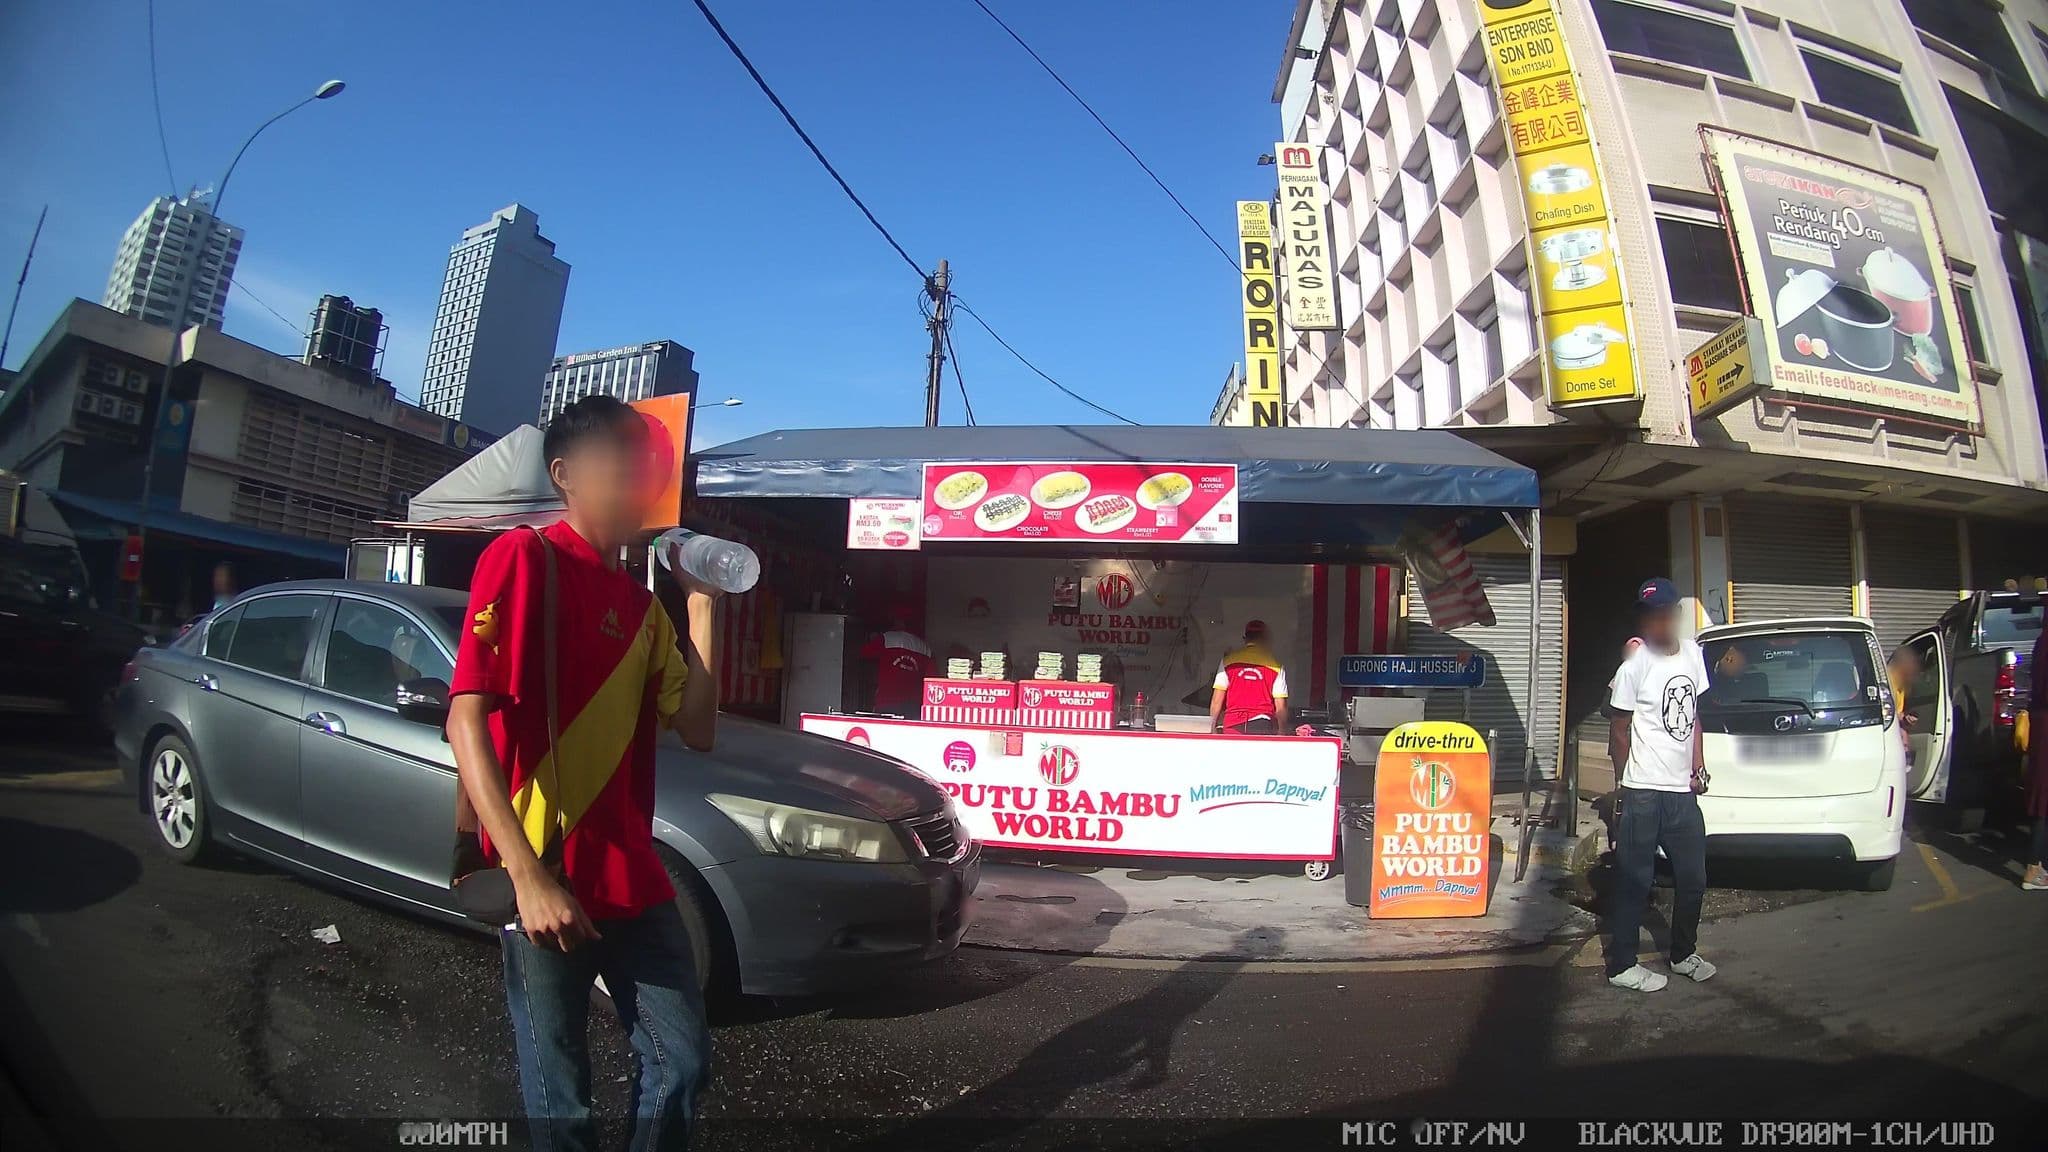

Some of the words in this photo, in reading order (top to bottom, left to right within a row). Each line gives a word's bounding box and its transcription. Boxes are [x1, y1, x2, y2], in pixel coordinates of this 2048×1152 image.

[1488, 17, 1555, 46] ENTERPRISE
[1499, 44, 1525, 64] SDN
[1504, 80, 1575, 115] 金峰企業
[1511, 111, 1583, 147] 有限公司
[1535, 205, 1572, 222] Chafing
[1574, 203, 1595, 215] Dish
[1773, 215, 1841, 249] Rendang
[1831, 207, 1864, 240] 40
[1288, 186, 1324, 289] MAJUMAS
[1865, 228, 1885, 243] cm
[597, 349, 623, 360] Garden
[623, 346, 638, 355] Inn
[1703, 341, 1725, 359] SYARIKAT
[1566, 380, 1596, 394] Dome
[1598, 377, 1616, 390] Set
[1048, 614, 1102, 627] PUTU
[1109, 615, 1181, 630] BAMBU
[1077, 629, 1150, 645] WORLD
[1347, 660, 1388, 673] LORONG
[1391, 660, 1416, 673] HAJI
[947, 687, 974, 696] PUTU
[975, 688, 1010, 697] BAMBU
[961, 695, 996, 704] WORLD
[1044, 689, 1070, 698] PUTU
[1073, 690, 1110, 699] BAMBU
[1058, 698, 1095, 706] WORLD
[1395, 731, 1475, 749] drive-thru
[1265, 778, 1327, 802] Dapnya!
[940, 782, 1038, 811] PUTU
[1047, 789, 1182, 818] BAMBU
[992, 812, 1124, 842] WORLD
[1395, 813, 1472, 833] PUTU
[1381, 834, 1483, 855] BAMBU
[1381, 856, 1482, 877] WORLD
[1435, 880, 1480, 897] Dapnya!
